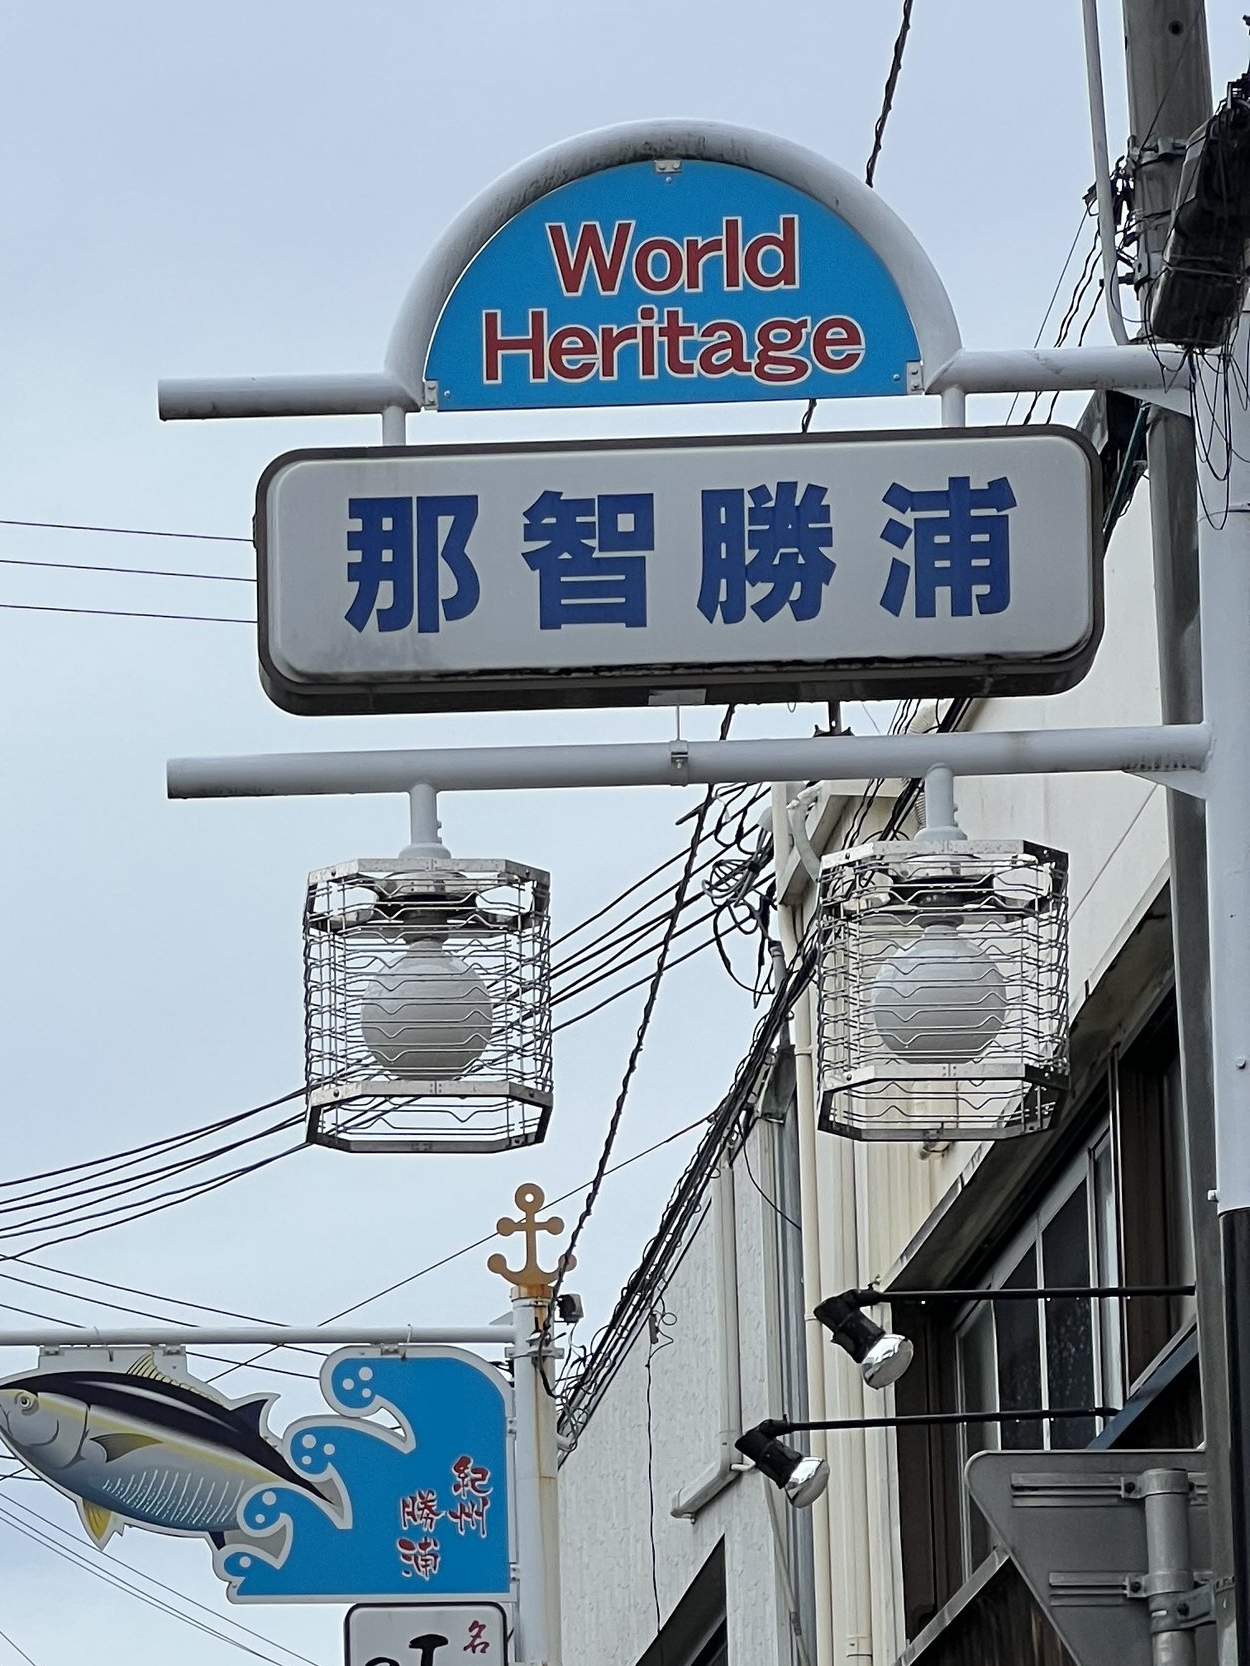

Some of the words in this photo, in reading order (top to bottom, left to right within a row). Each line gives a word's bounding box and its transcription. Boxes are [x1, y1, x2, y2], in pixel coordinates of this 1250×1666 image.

[545, 214, 800, 298] World
[481, 306, 865, 385] Heritage
[346, 476, 1016, 634] 那智勝浦
[396, 1488, 445, 1580] 勝浦
[449, 1454, 492, 1539] 紀州
